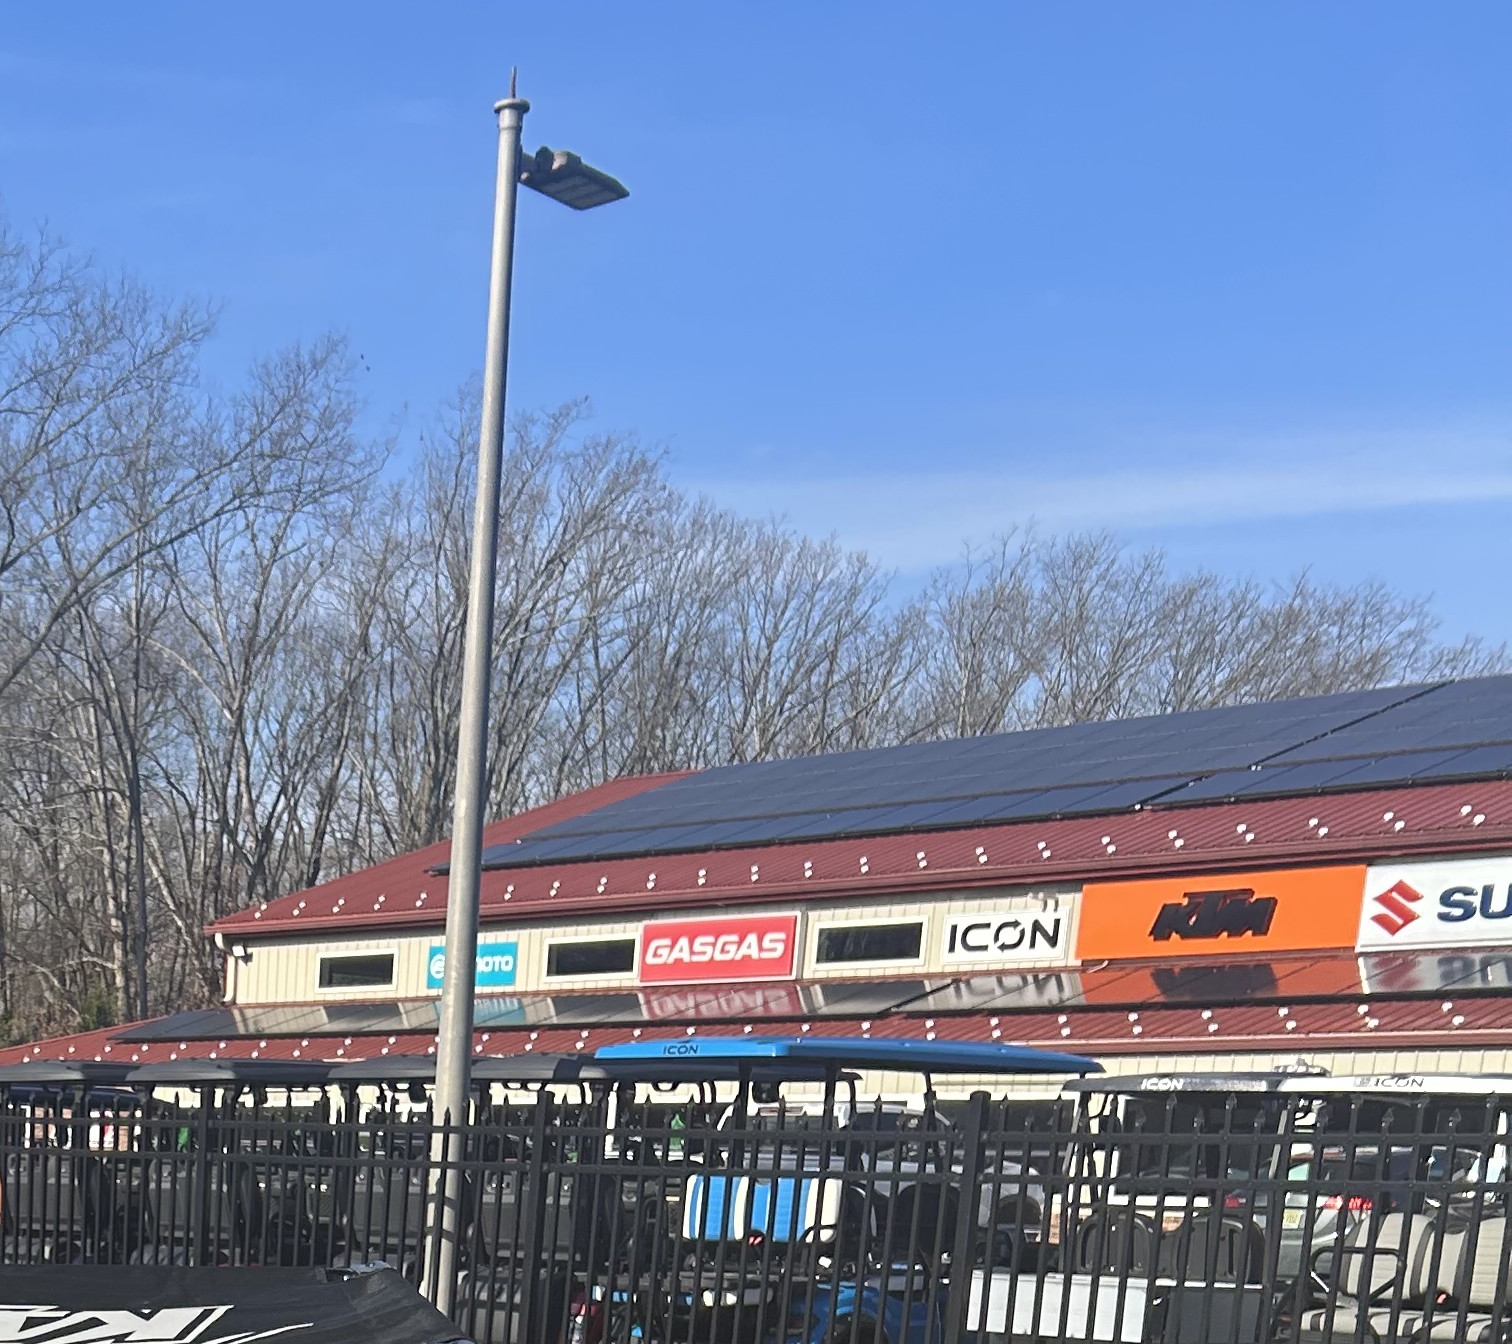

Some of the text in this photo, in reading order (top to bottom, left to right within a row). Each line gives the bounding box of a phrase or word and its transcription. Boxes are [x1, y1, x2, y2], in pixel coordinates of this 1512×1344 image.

[1148, 888, 1278, 942] KTM
[645, 931, 786, 965] GASGAS
[948, 918, 1061, 954] ICON
[663, 1044, 699, 1056] ICON
[1140, 1077, 1184, 1091] ICON
[1374, 1077, 1424, 1087] ICON
